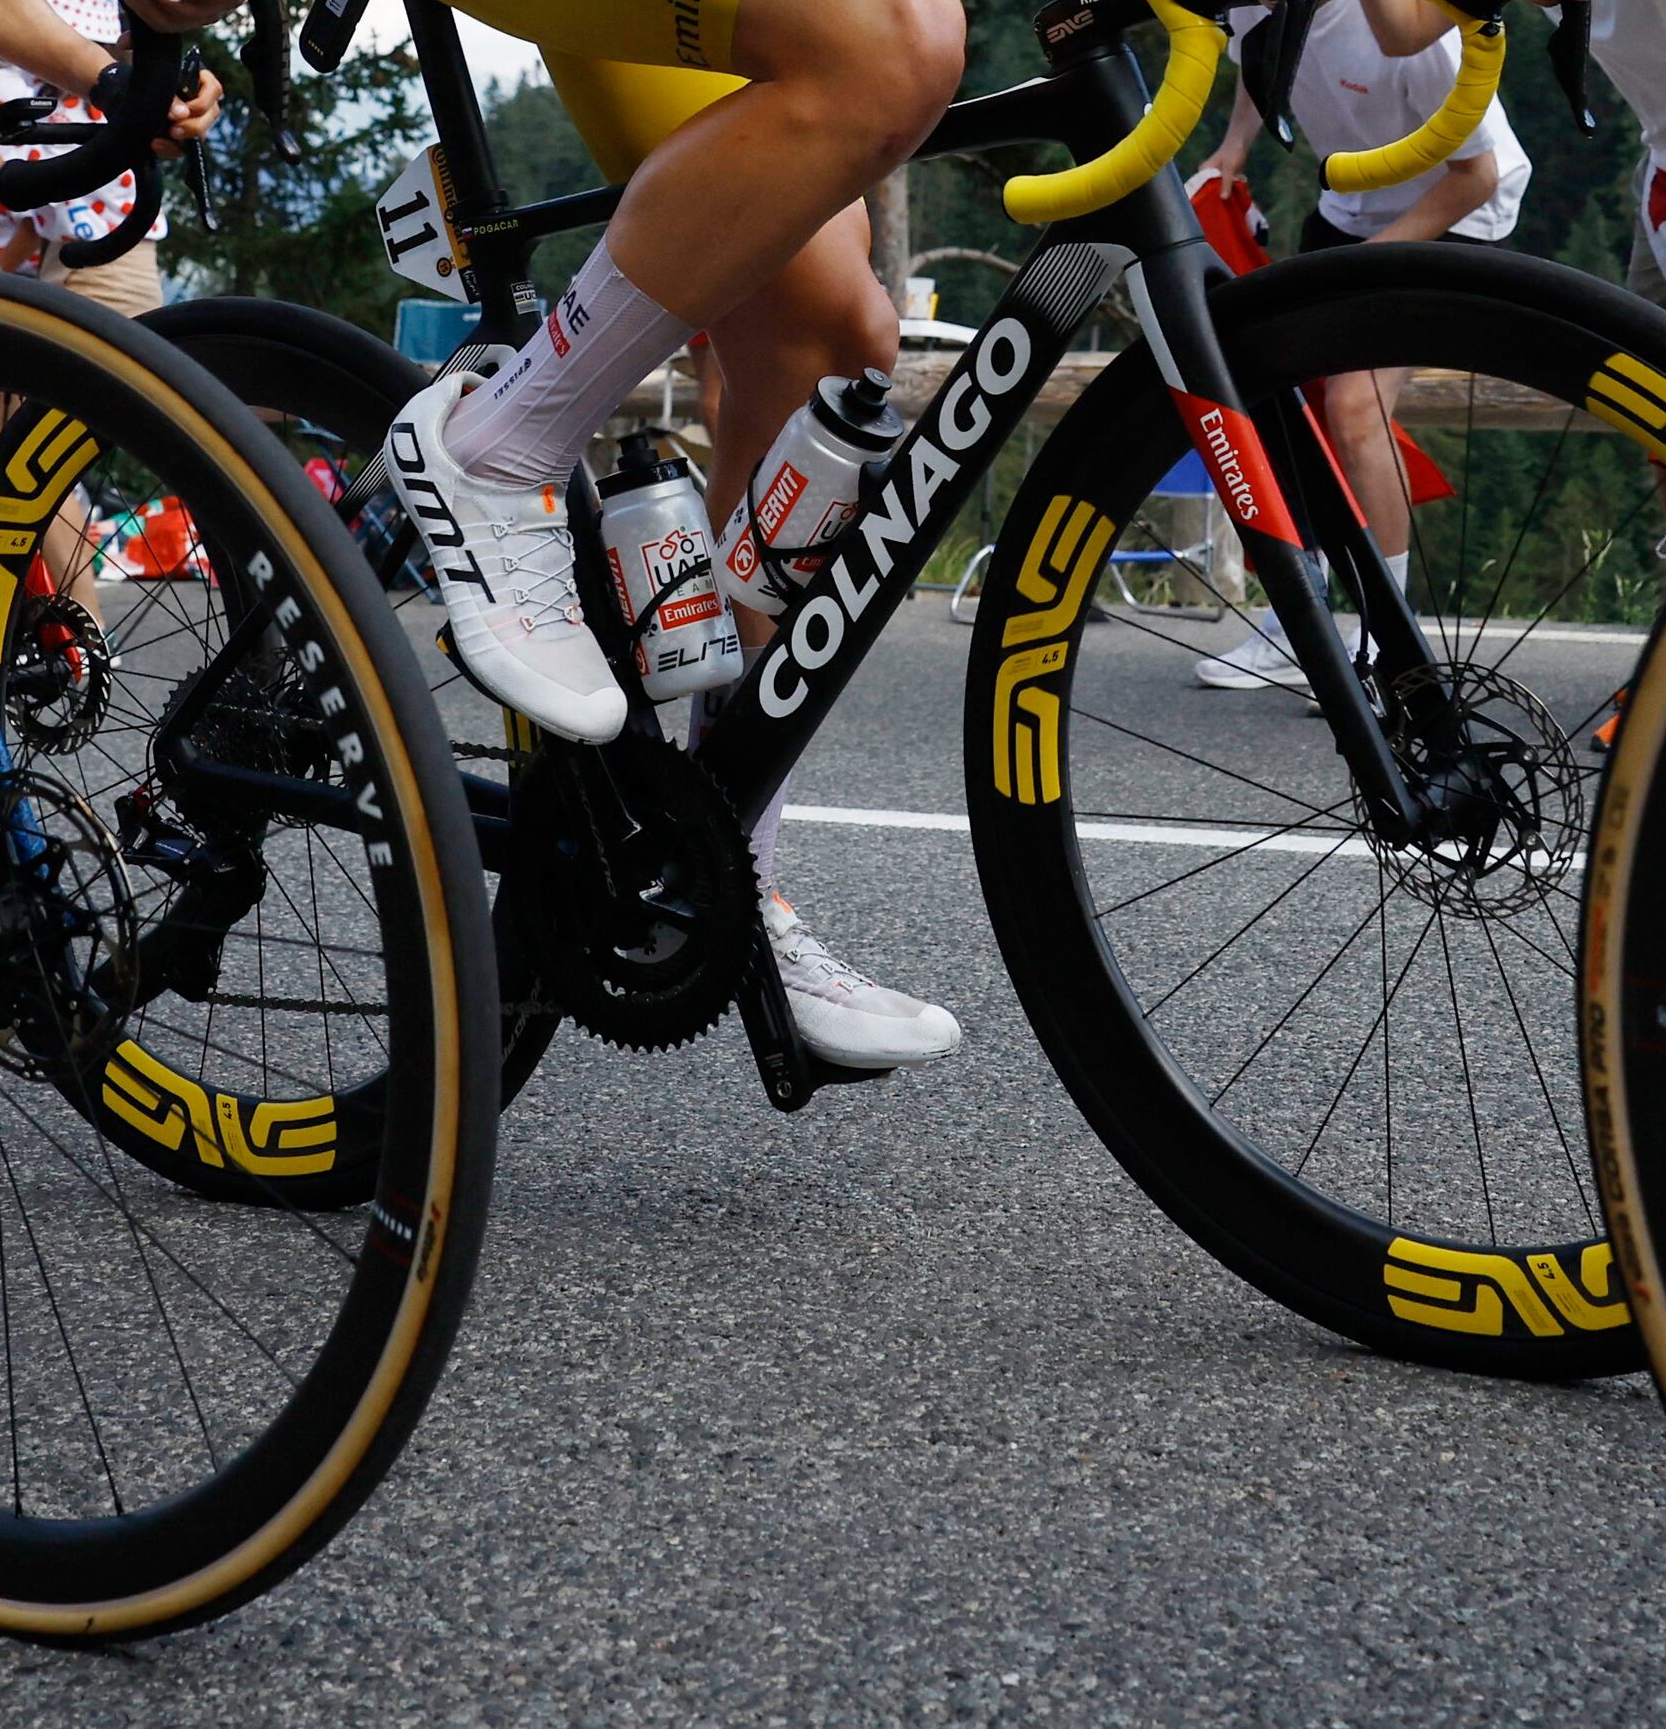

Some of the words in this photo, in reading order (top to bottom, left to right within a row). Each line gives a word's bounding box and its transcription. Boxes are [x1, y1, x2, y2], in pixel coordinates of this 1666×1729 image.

[379, 190, 439, 265] 11
[474, 219, 519, 237] POGACAR
[1199, 407, 1261, 524] Emirates
[759, 318, 1032, 719] COLNAGO
[10, 536, 28, 549] 4.5
[676, 579, 714, 598] EAM
[664, 598, 719, 623] Emirates
[1041, 649, 1061, 665] 4.5
[247, 549, 393, 871] RESERVE
